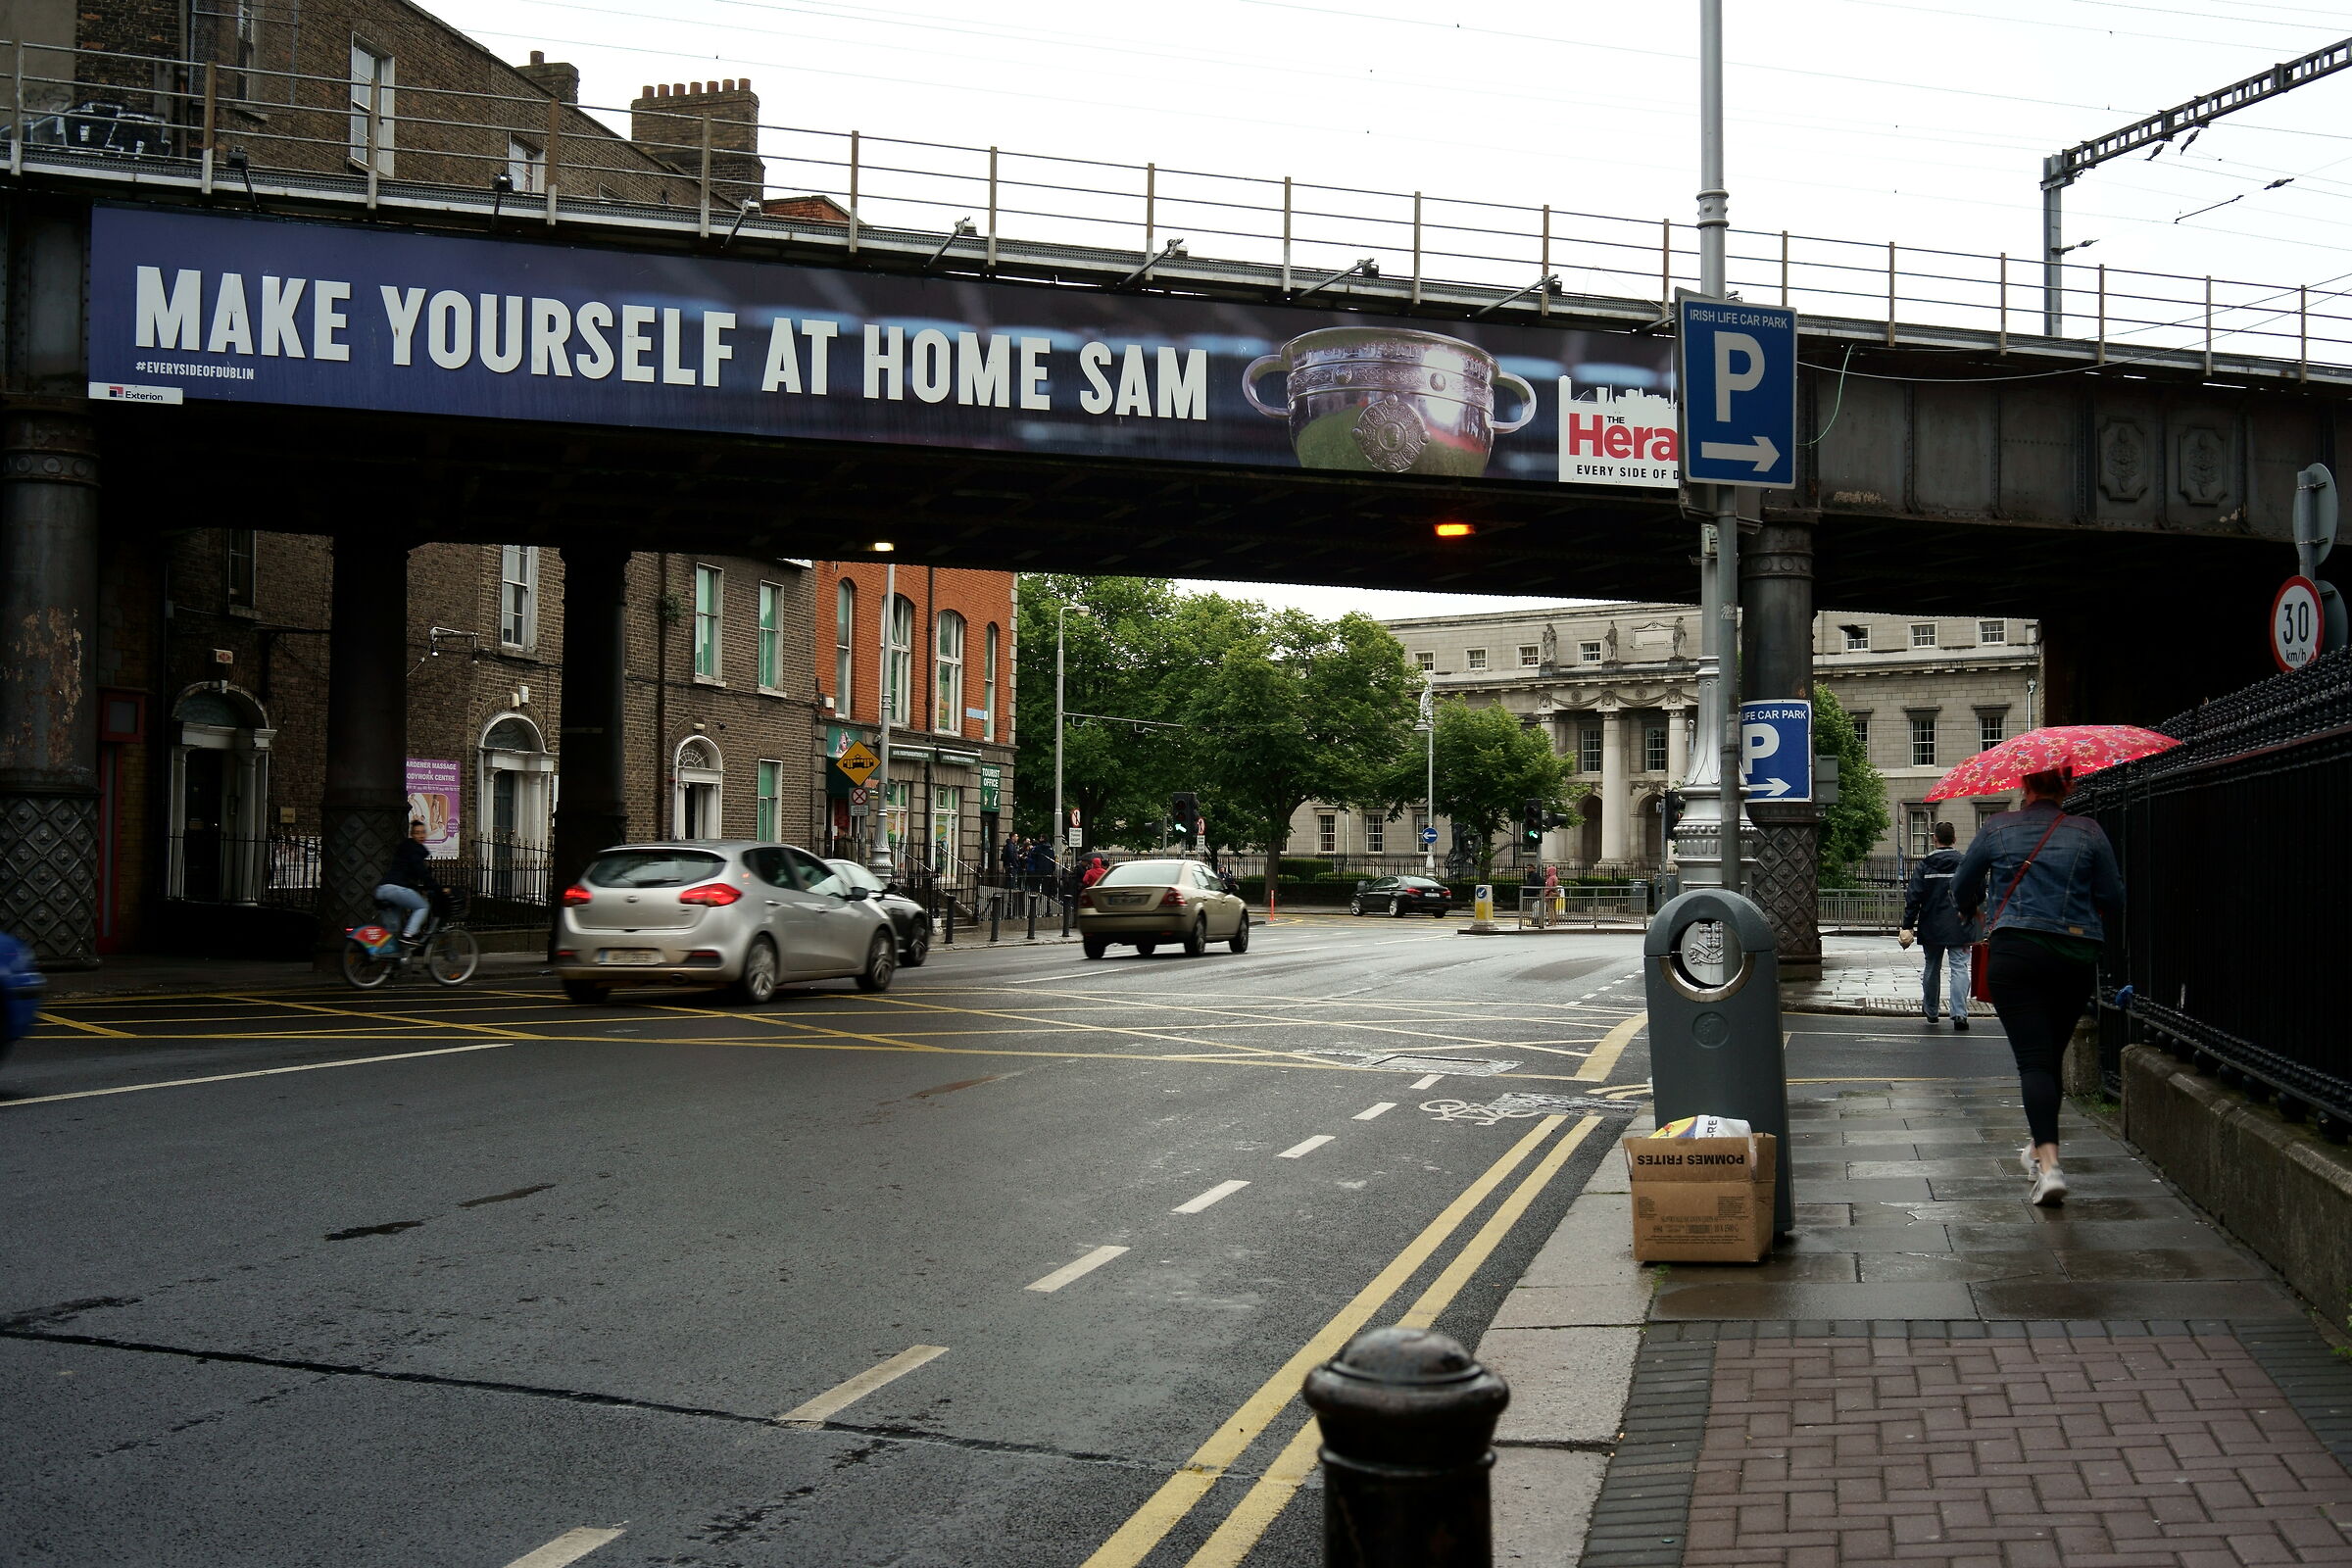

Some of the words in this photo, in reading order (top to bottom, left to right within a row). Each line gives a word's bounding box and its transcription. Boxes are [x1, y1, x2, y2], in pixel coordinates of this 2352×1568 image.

[1690, 309, 1715, 322] IRISH
[1717, 312, 1739, 324] LIFE
[1740, 314, 1760, 326] CAR
[1762, 316, 1788, 329] PARK
[135, 265, 352, 363] MAKE
[379, 284, 737, 388] YOURSELF
[761, 317, 839, 396] AT
[862, 322, 1052, 412] HOME
[1078, 340, 1208, 421] SAM
[135, 361, 255, 380] #EVERYSIDEOFDUBLIN
[1714, 330, 1766, 423] P
[124, 390, 164, 401] Exterion
[1606, 416, 1625, 424] THE
[1576, 465, 1614, 476] EVERY
[1619, 466, 1647, 478] SIDE
[1652, 468, 1667, 479] OF
[2282, 600, 2309, 645] 30
[2285, 648, 2307, 662] km/h
[1757, 710, 1780, 720] CAR
[1782, 710, 1806, 720] PARK
[1741, 722, 1780, 774] P
[982, 767, 1001, 778] TOURIST
[983, 777, 999, 788] OFFICE
[1637, 1154, 1683, 1165] FRITES
[1687, 1154, 1745, 1165] POMMES
